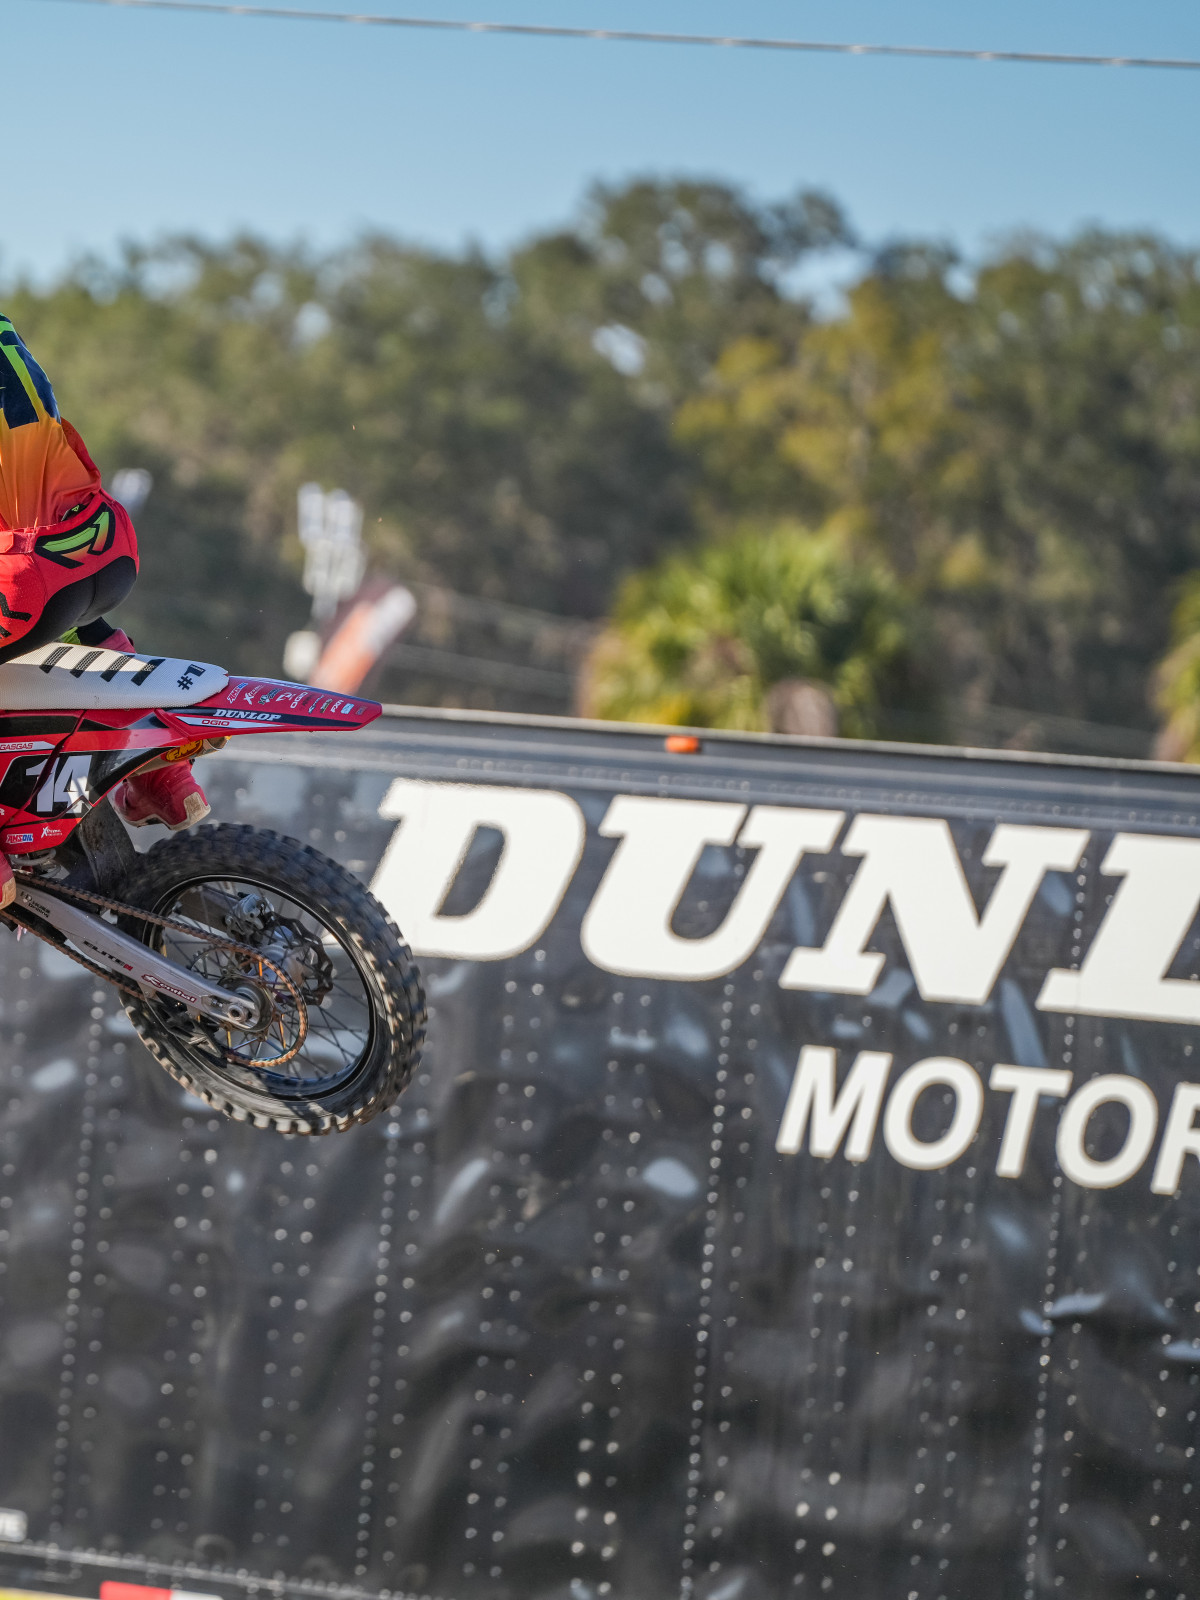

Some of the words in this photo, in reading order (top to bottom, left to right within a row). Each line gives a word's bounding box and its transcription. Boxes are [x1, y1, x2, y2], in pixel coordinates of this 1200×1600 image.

[212, 708, 282, 722] DUNLOP
[201, 719, 231, 727] OGIO
[0, 742, 34, 751] GASGAS
[25, 754, 93, 814] 14
[5, 833, 34, 845] AMSOIL
[369, 777, 1200, 1026] DUNL
[141, 974, 196, 1004] Renthal
